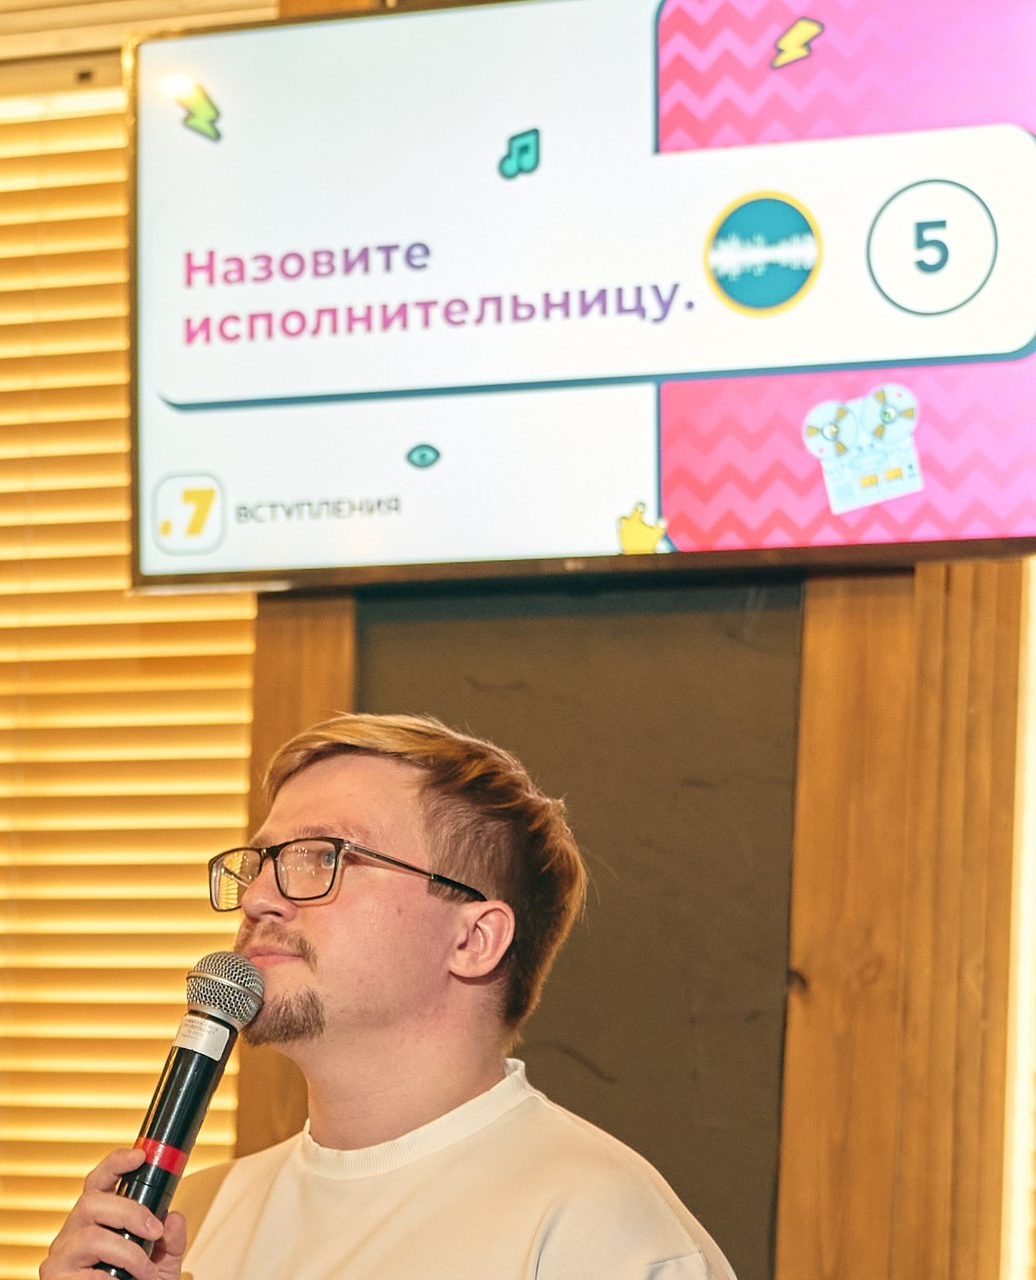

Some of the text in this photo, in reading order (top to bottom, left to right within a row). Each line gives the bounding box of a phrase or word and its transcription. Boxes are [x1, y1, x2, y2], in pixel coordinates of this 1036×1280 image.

[184, 241, 432, 289] Назовите
[915, 220, 950, 274] 5
[184, 283, 695, 346] исполнительницу.
[235, 496, 402, 525] ВСТУПЛЕНИЯ
